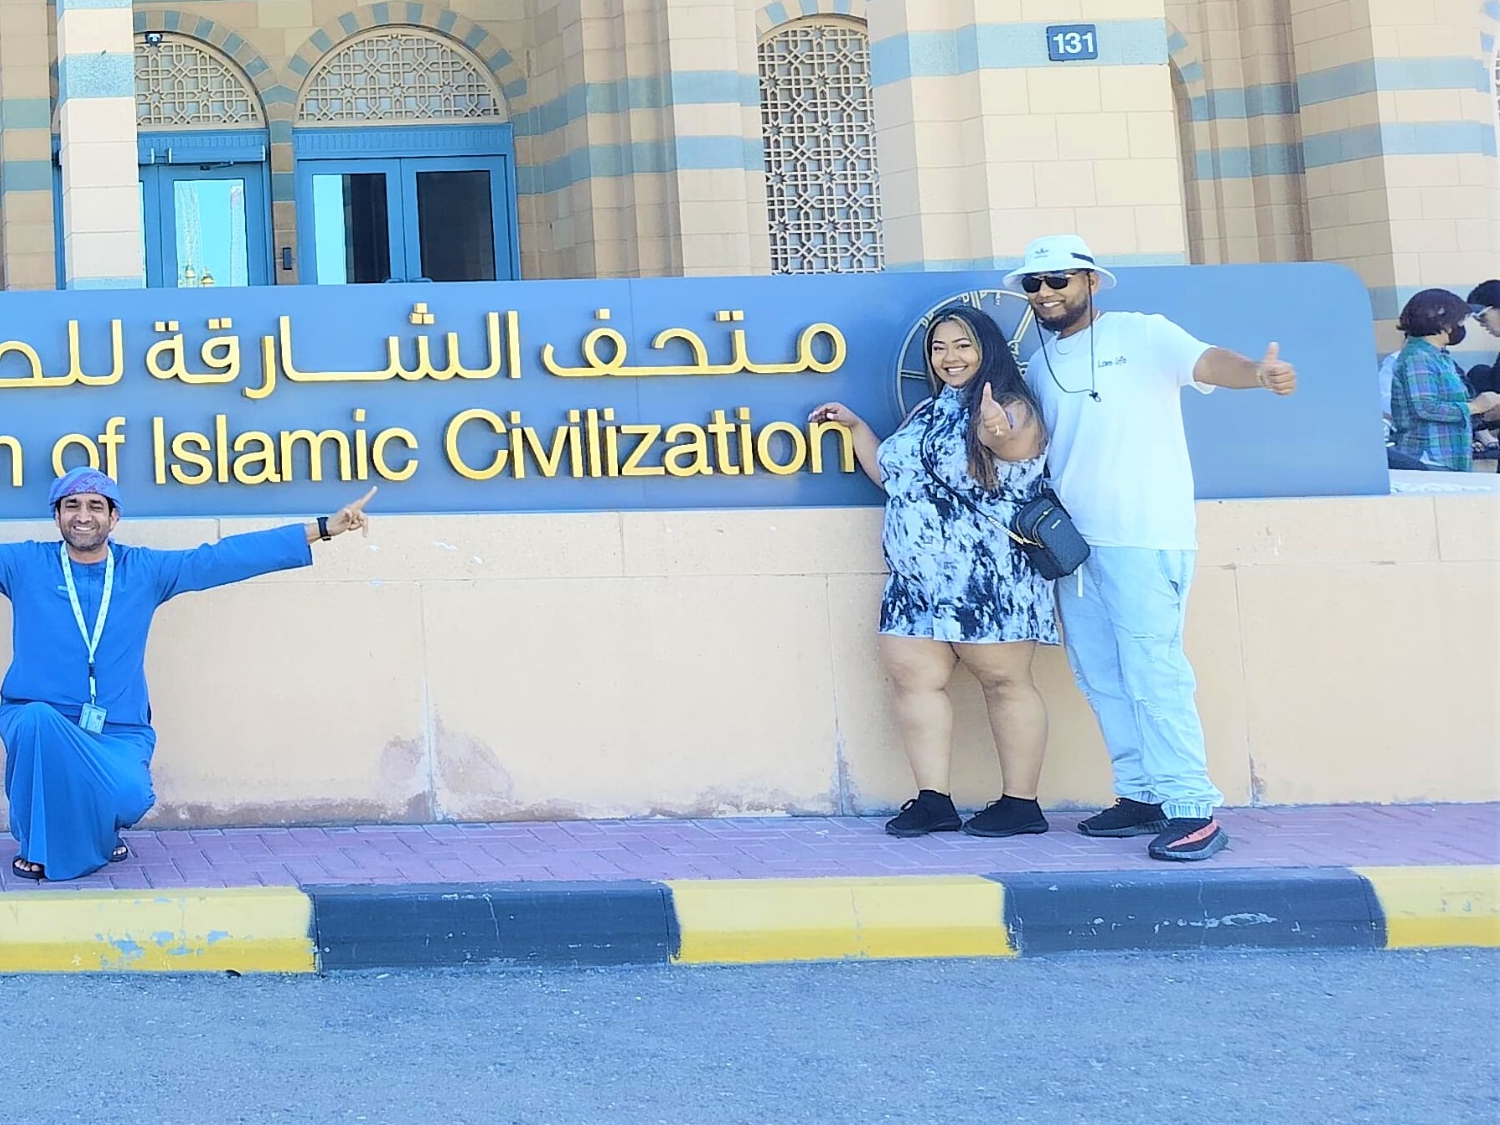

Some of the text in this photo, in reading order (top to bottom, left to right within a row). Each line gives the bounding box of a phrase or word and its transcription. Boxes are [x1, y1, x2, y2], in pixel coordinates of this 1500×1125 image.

[1052, 31, 1095, 55] 131
[145, 303, 522, 400] الشارقة
[542, 308, 848, 380] متحف
[51, 416, 126, 484] of
[152, 408, 419, 486] Islamic
[444, 407, 856, 480] Civilization
